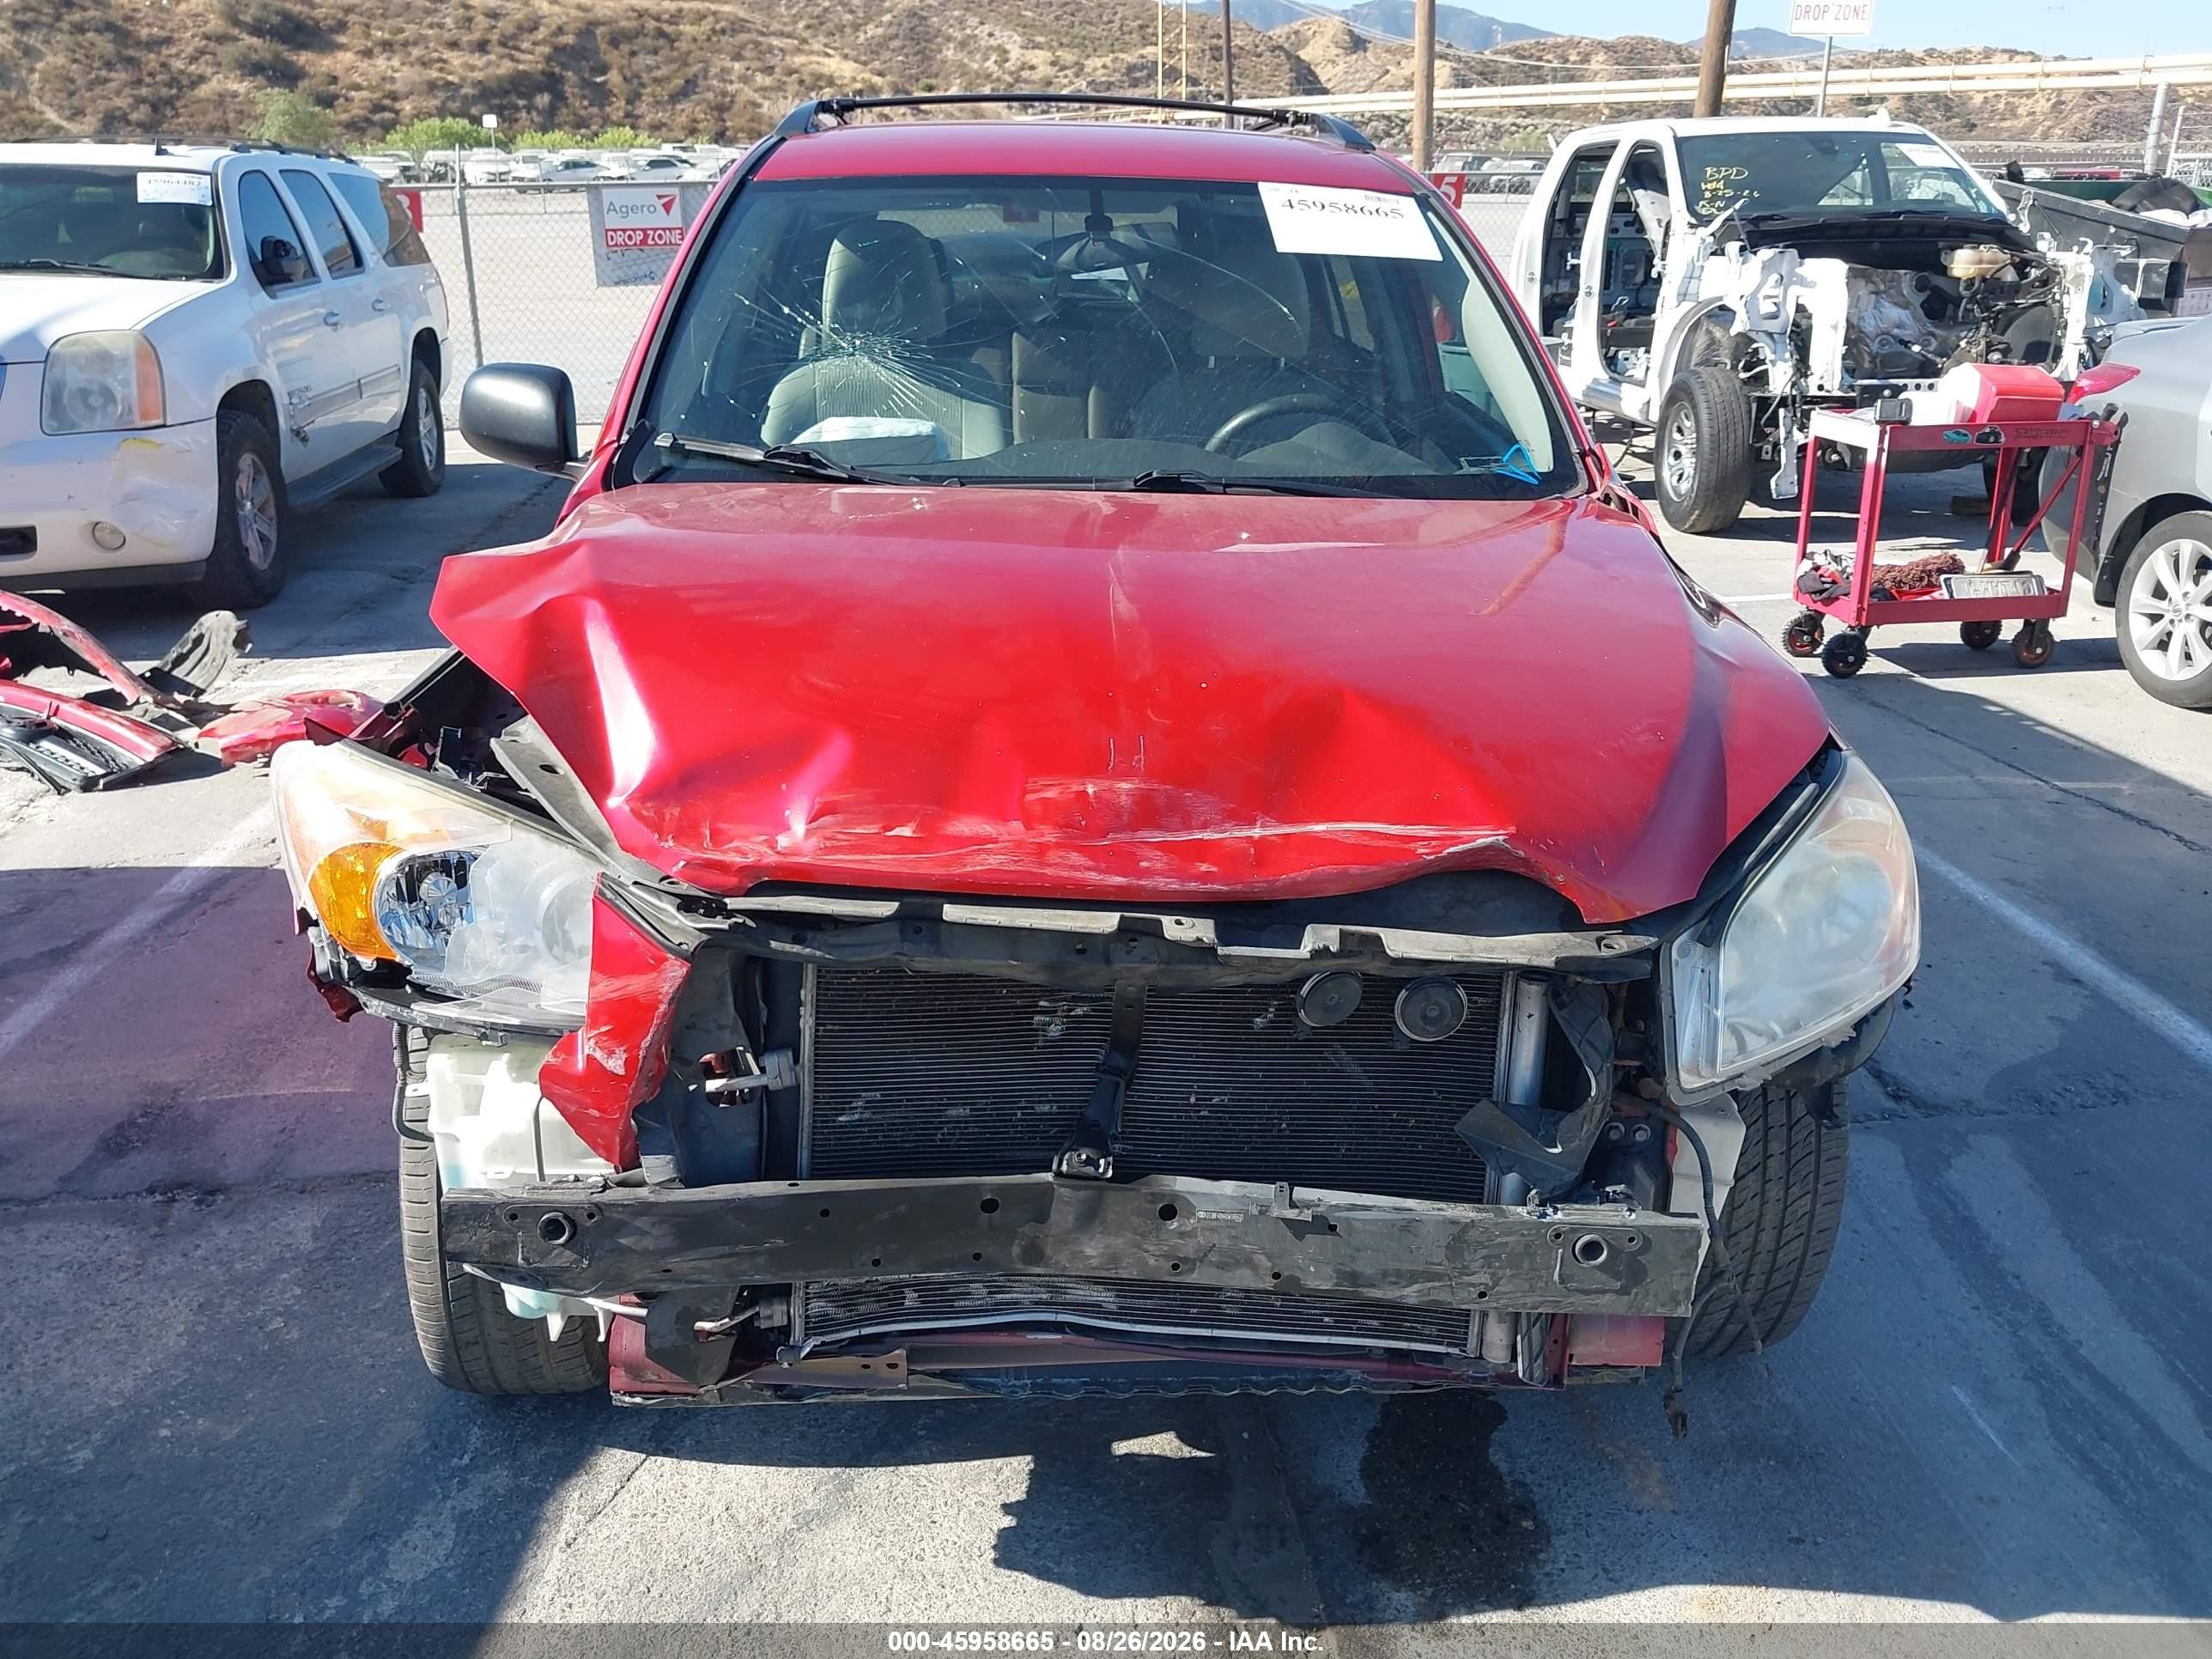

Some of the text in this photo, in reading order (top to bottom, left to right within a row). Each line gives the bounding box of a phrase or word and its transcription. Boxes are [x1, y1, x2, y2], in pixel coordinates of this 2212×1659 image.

[1795, 4, 1869, 21] DROP ZONE
[1704, 167, 1749, 180] BPD
[1439, 176, 1457, 204] 5
[606, 201, 657, 218] Agero
[1281, 198, 1404, 219] 45958665
[607, 229, 684, 246] DROP ZONE
